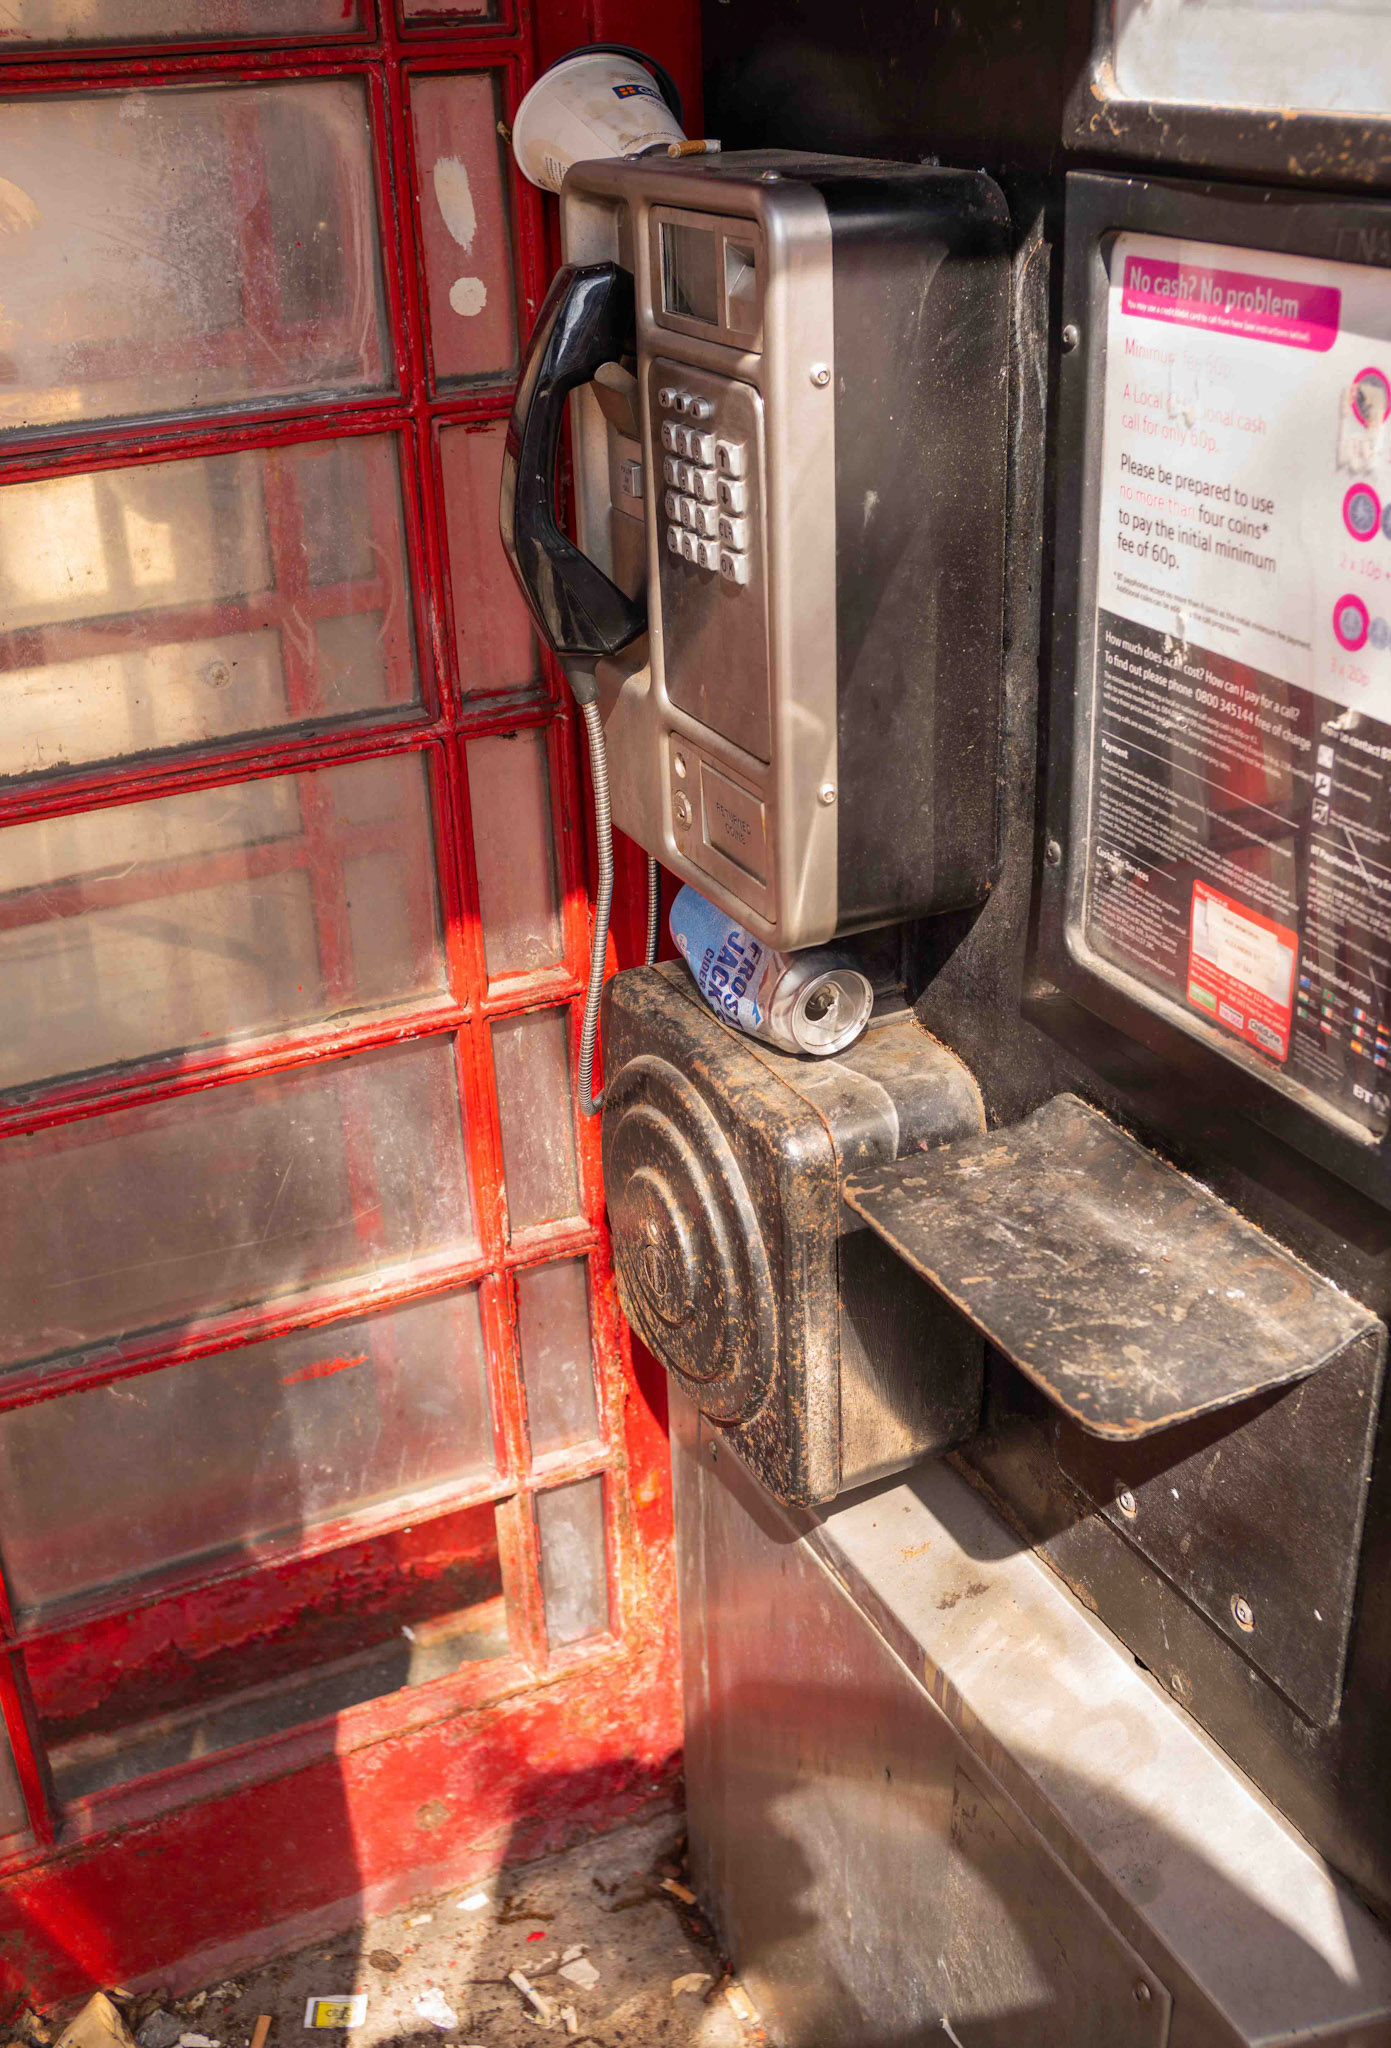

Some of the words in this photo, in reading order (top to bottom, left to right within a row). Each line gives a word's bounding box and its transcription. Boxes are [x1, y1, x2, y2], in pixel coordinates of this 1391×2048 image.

[1129, 265, 1150, 292] No
[1153, 273, 1195, 300] cash?
[1200, 277, 1223, 306] No
[1225, 286, 1299, 319] problem
[1124, 383, 1130, 399] A
[1134, 387, 1163, 410] Local
[1237, 413, 1267, 434] cash
[1121, 411, 1139, 430] call
[1143, 418, 1159, 436] for
[1162, 425, 1186, 448] only
[1191, 430, 1219, 454] 60p.
[1120, 484, 1133, 501] no
[1136, 489, 1165, 508] more
[1168, 494, 1194, 517] than
[1198, 504, 1224, 527] four
[1121, 453, 1155, 481] Please
[1158, 463, 1172, 486] be
[1175, 473, 1231, 502] prepared
[1234, 489, 1248, 507] to
[1252, 496, 1274, 515] use
[719, 522, 733, 541] CLR
[1117, 531, 1134, 553] fee
[1137, 540, 1150, 558] of
[1152, 543, 1180, 570] 60p.
[1118, 508, 1130, 526] to
[1133, 516, 1151, 538] pay
[1155, 519, 1174, 540] the
[1178, 524, 1212, 551] initial
[1215, 540, 1276, 573] minimum
[721, 558, 734, 575] OK
[1105, 631, 1122, 647] How
[1122, 638, 1143, 655] much
[1144, 646, 1162, 663] does
[1184, 661, 1204, 681] cost?
[1205, 670, 1225, 689] How
[1225, 678, 1240, 696] can
[1240, 685, 1244, 698] I
[1244, 686, 1259, 704] pay
[1260, 693, 1274, 710] for
[1280, 701, 1300, 721] call?
[1104, 650, 1113, 664] To
[1114, 655, 1128, 671] find
[1129, 661, 1142, 677] out
[1143, 667, 1167, 688] please
[1168, 678, 1193, 699] phone
[1195, 690, 1218, 711] 0800
[1219, 700, 1254, 726] 345144
[1254, 715, 1271, 734] free
[1272, 722, 1282, 739] of
[1282, 727, 1311, 752] charge
[1101, 738, 1128, 759] Payment
[716, 801, 752, 836] RETURNED
[1096, 845, 1125, 868] Customer
[1125, 861, 1149, 881] Services
[1320, 849, 1352, 872] Payphones
[700, 947, 715, 990] CIDER
[1302, 958, 1349, 990] International
[1349, 984, 1372, 1004] codes
[1353, 1083, 1374, 1103] BT
